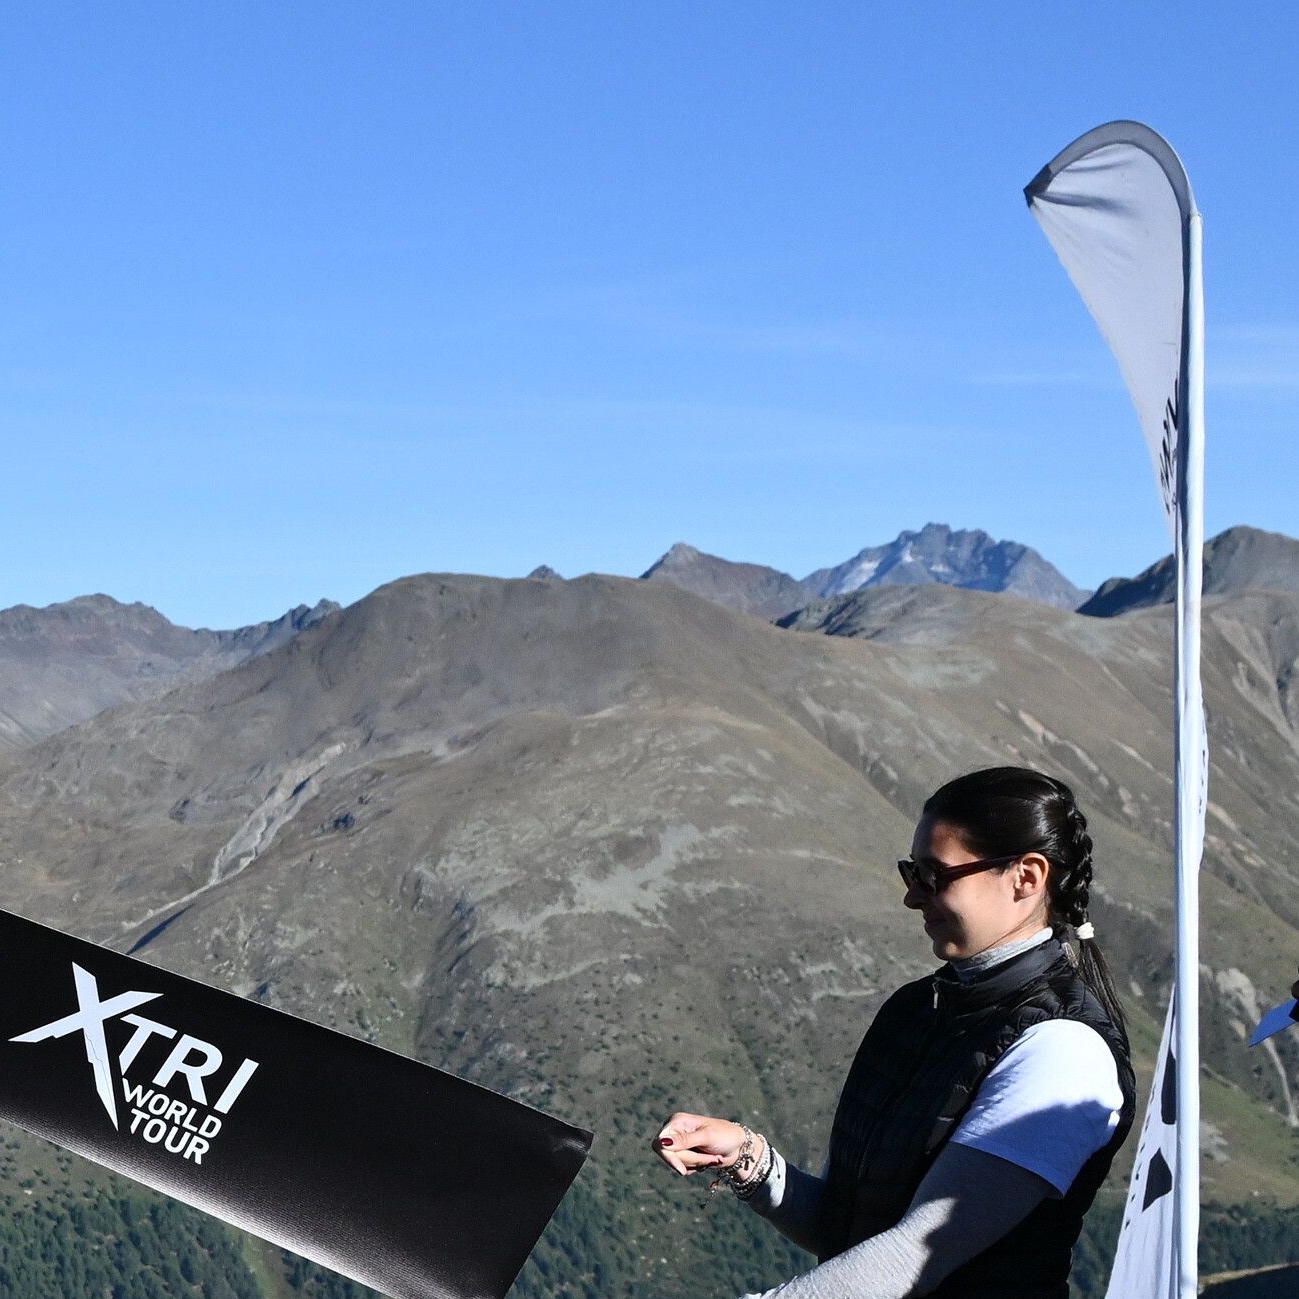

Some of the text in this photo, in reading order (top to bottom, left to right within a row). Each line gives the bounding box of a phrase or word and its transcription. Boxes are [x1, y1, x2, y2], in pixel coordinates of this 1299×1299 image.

[8, 961, 259, 1131] XTRI
[123, 1078, 222, 1140] WORLD
[129, 1109, 211, 1165] TOUR
